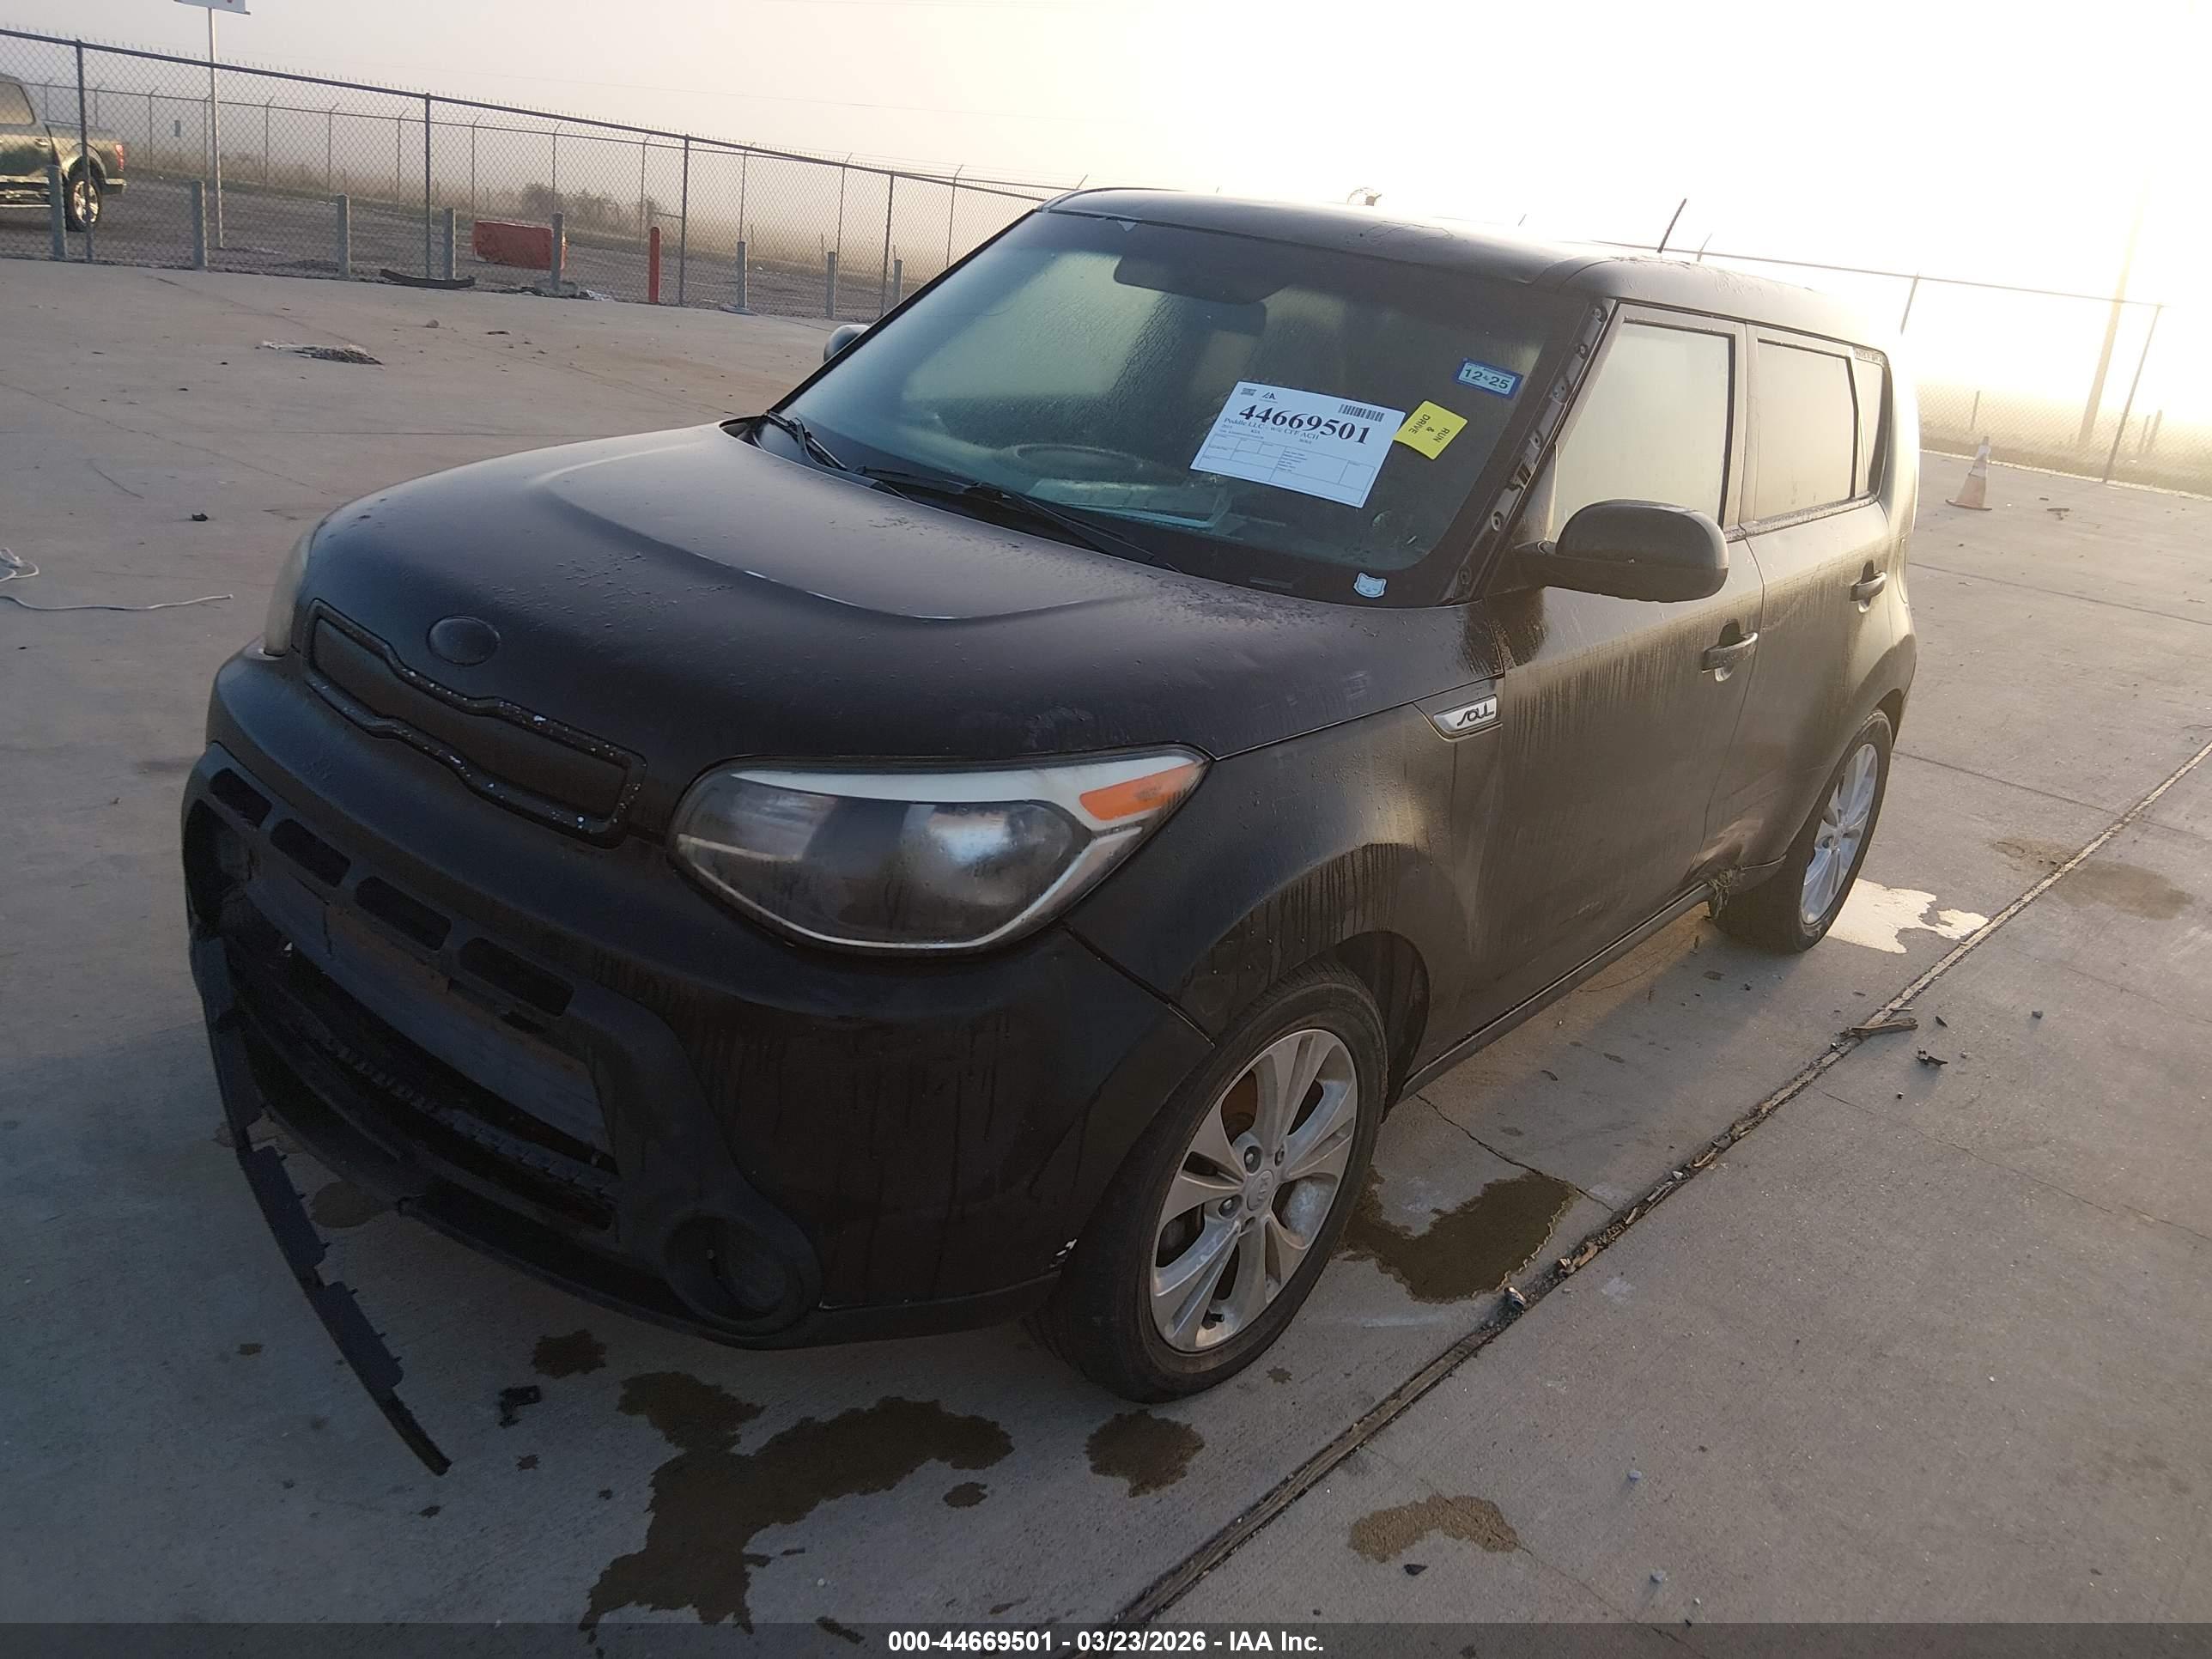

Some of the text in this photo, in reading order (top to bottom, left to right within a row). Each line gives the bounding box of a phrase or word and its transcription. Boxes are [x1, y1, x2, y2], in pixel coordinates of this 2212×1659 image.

[1238, 404, 1371, 446] 44669501
[1408, 414, 1431, 434] DRIVE
[1433, 427, 1450, 443] RUN
